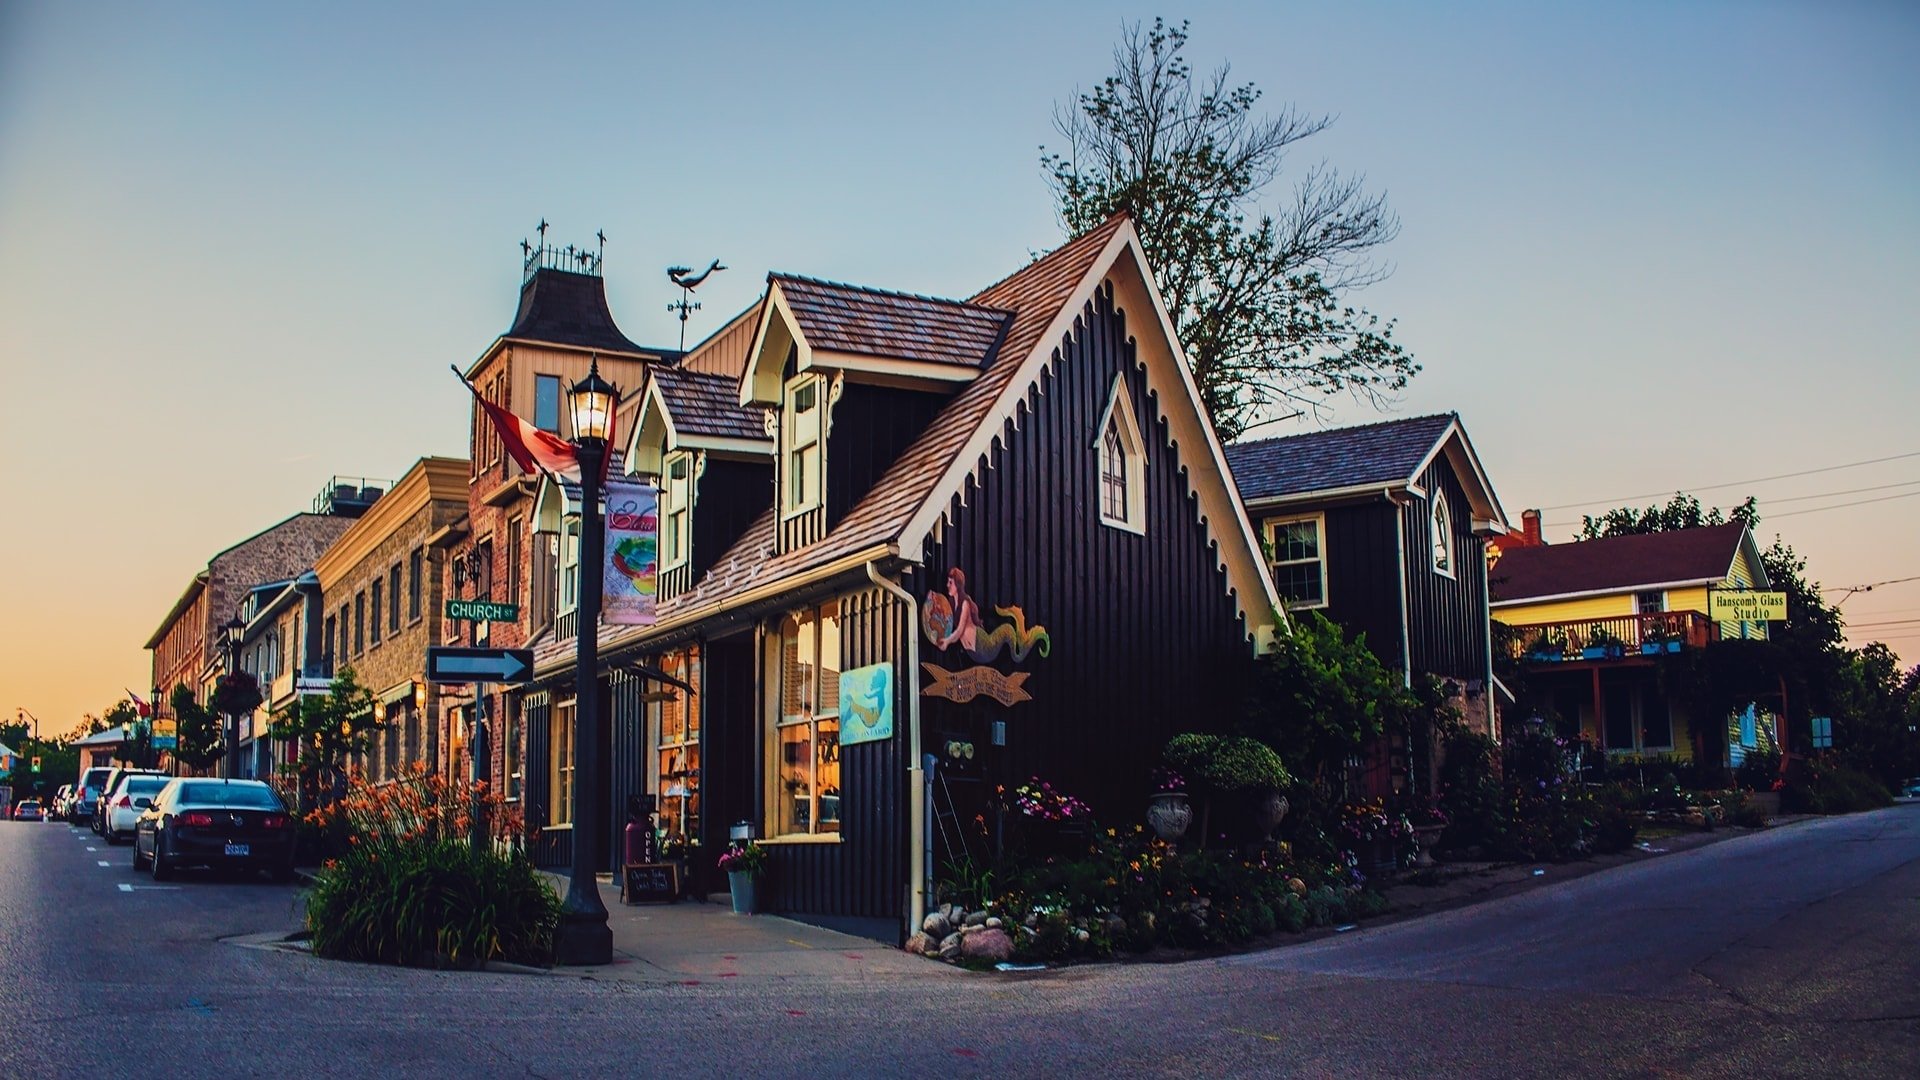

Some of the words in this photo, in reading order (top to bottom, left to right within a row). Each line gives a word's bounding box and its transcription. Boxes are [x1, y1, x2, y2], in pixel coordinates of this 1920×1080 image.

[1717, 595, 1757, 607] Hanscomb
[1760, 595, 1783, 606] Glass
[450, 603, 502, 619] CHURCH
[504, 608, 514, 618] ST
[1733, 606, 1770, 619] Studio
[644, 831, 652, 863] OPEN
